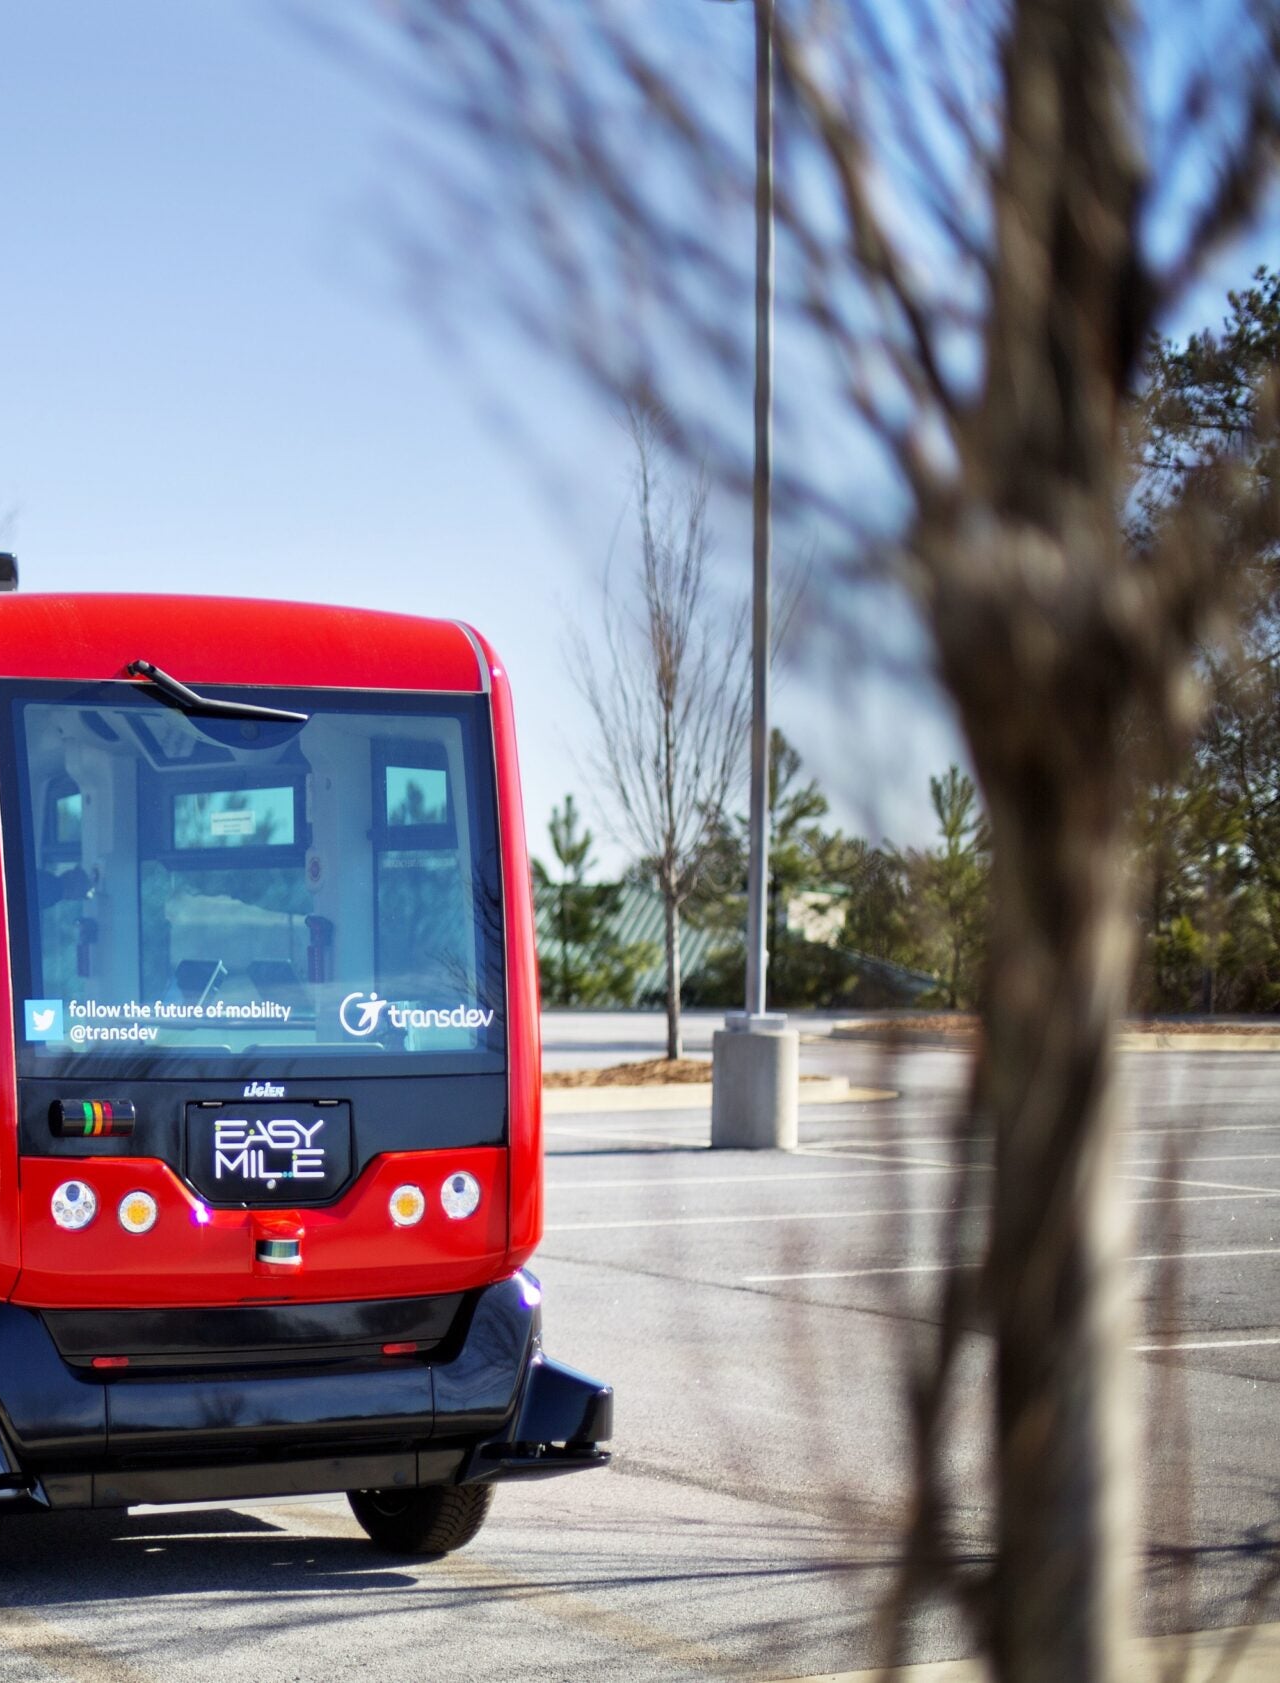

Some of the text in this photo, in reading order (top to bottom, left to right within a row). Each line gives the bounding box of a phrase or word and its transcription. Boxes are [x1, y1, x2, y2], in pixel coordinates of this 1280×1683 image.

[69, 1001, 291, 1021] follow the future of mobility
[388, 1004, 494, 1028] transdev
[70, 1023, 158, 1042] @transdev
[214, 1119, 324, 1149] EASY
[215, 1149, 325, 1179] MILE
